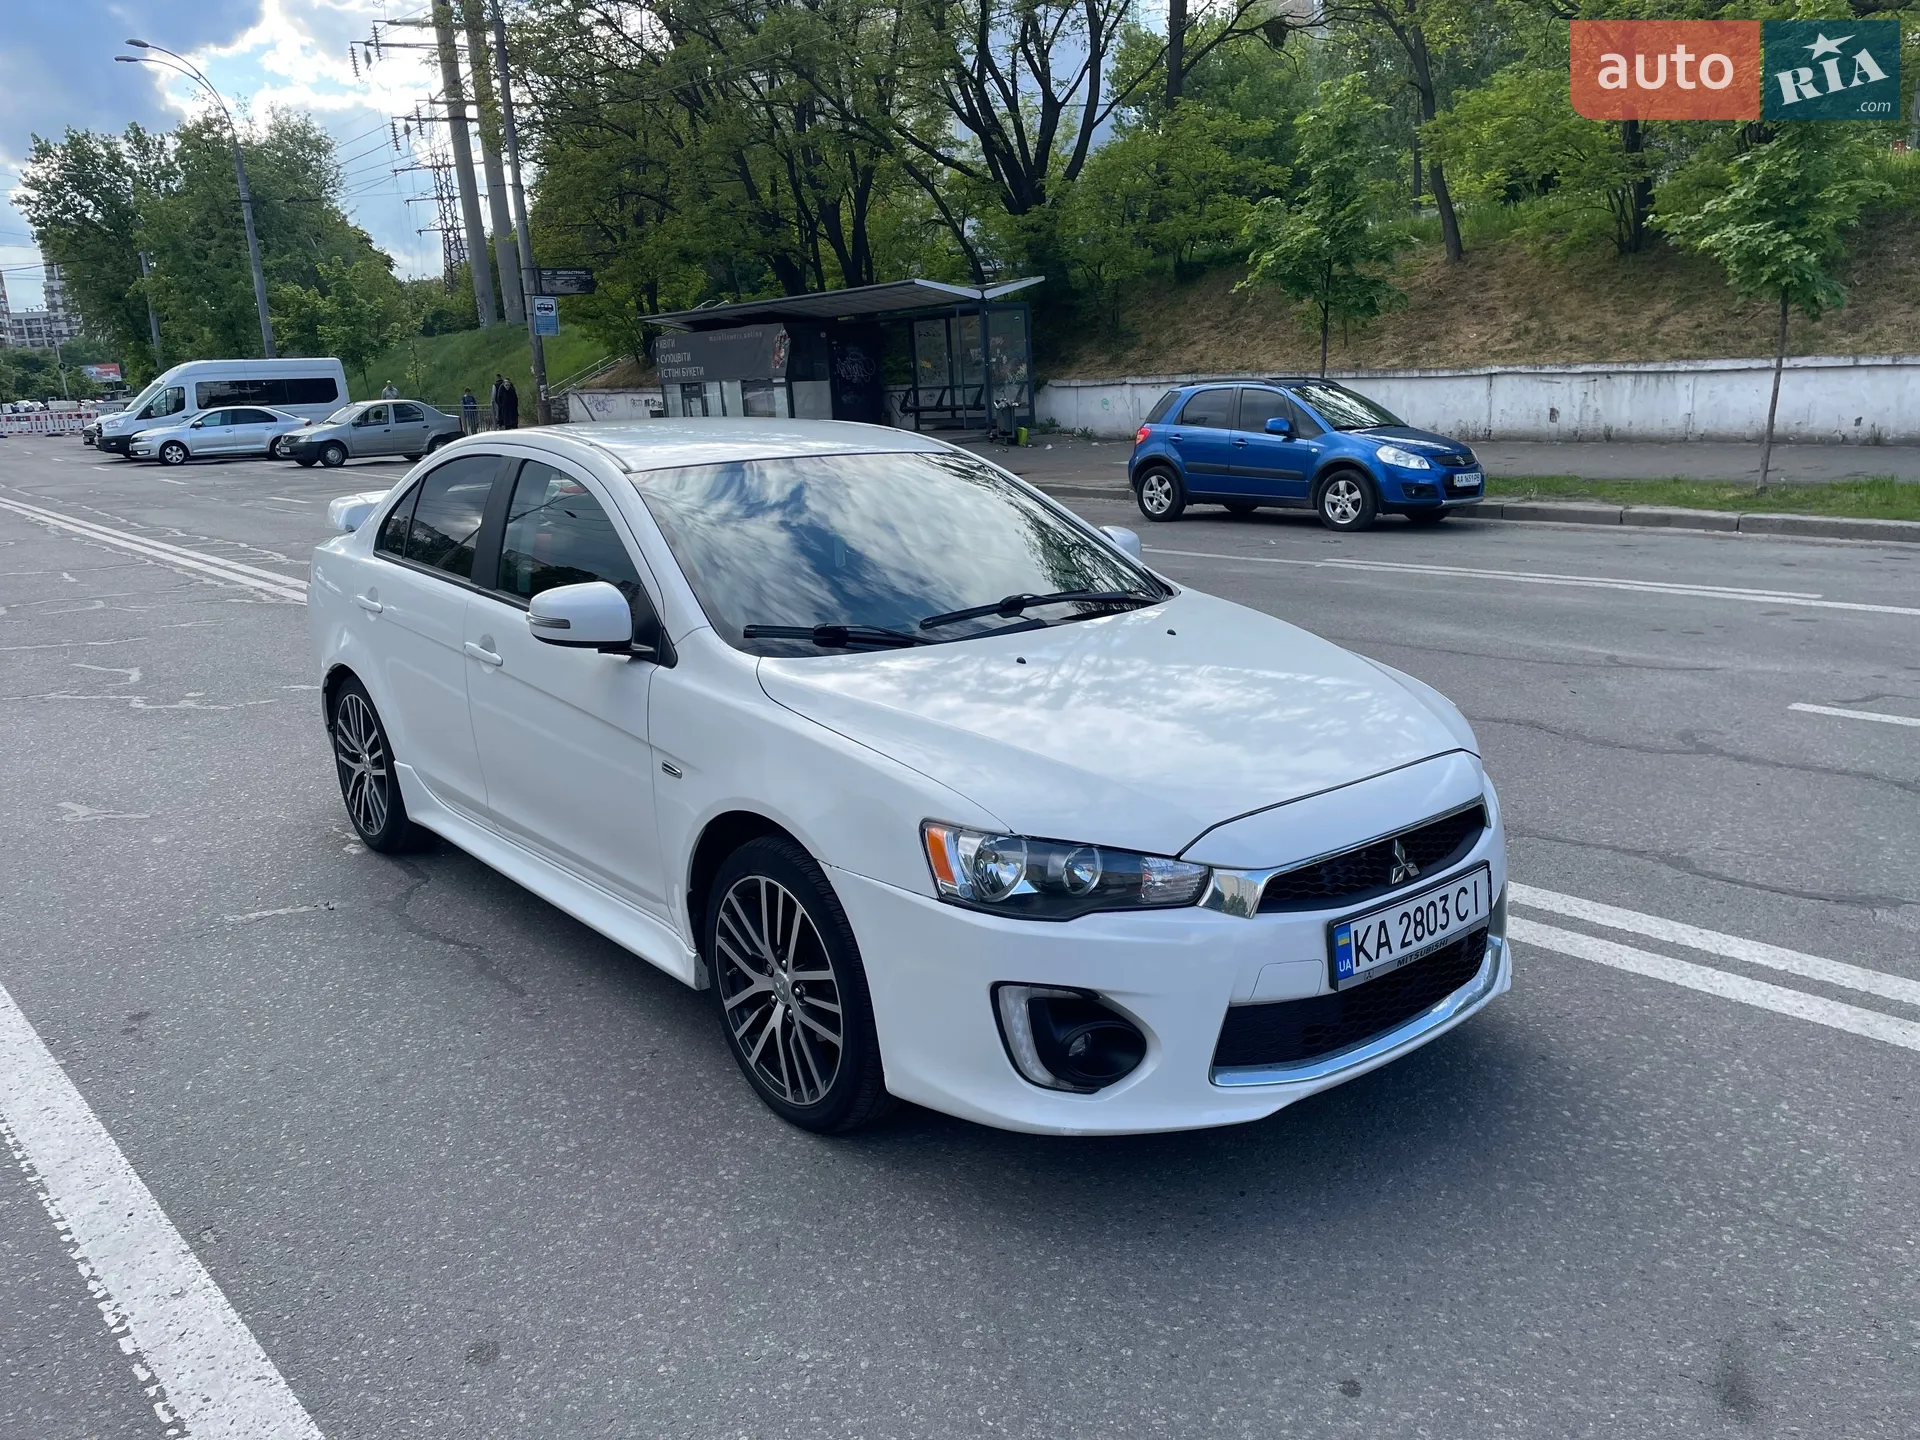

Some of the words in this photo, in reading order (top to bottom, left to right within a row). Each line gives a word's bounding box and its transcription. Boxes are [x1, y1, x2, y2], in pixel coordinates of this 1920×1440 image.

[659, 338, 676, 349] КВІТИ
[681, 366, 705, 378] БУКЕТИ
[1353, 919, 1393, 968] KA
[1398, 893, 1450, 950] 2803
[1455, 880, 1479, 922] CI
[1396, 939, 1449, 967] MITSUBISHI
[1338, 960, 1352, 973] UA
